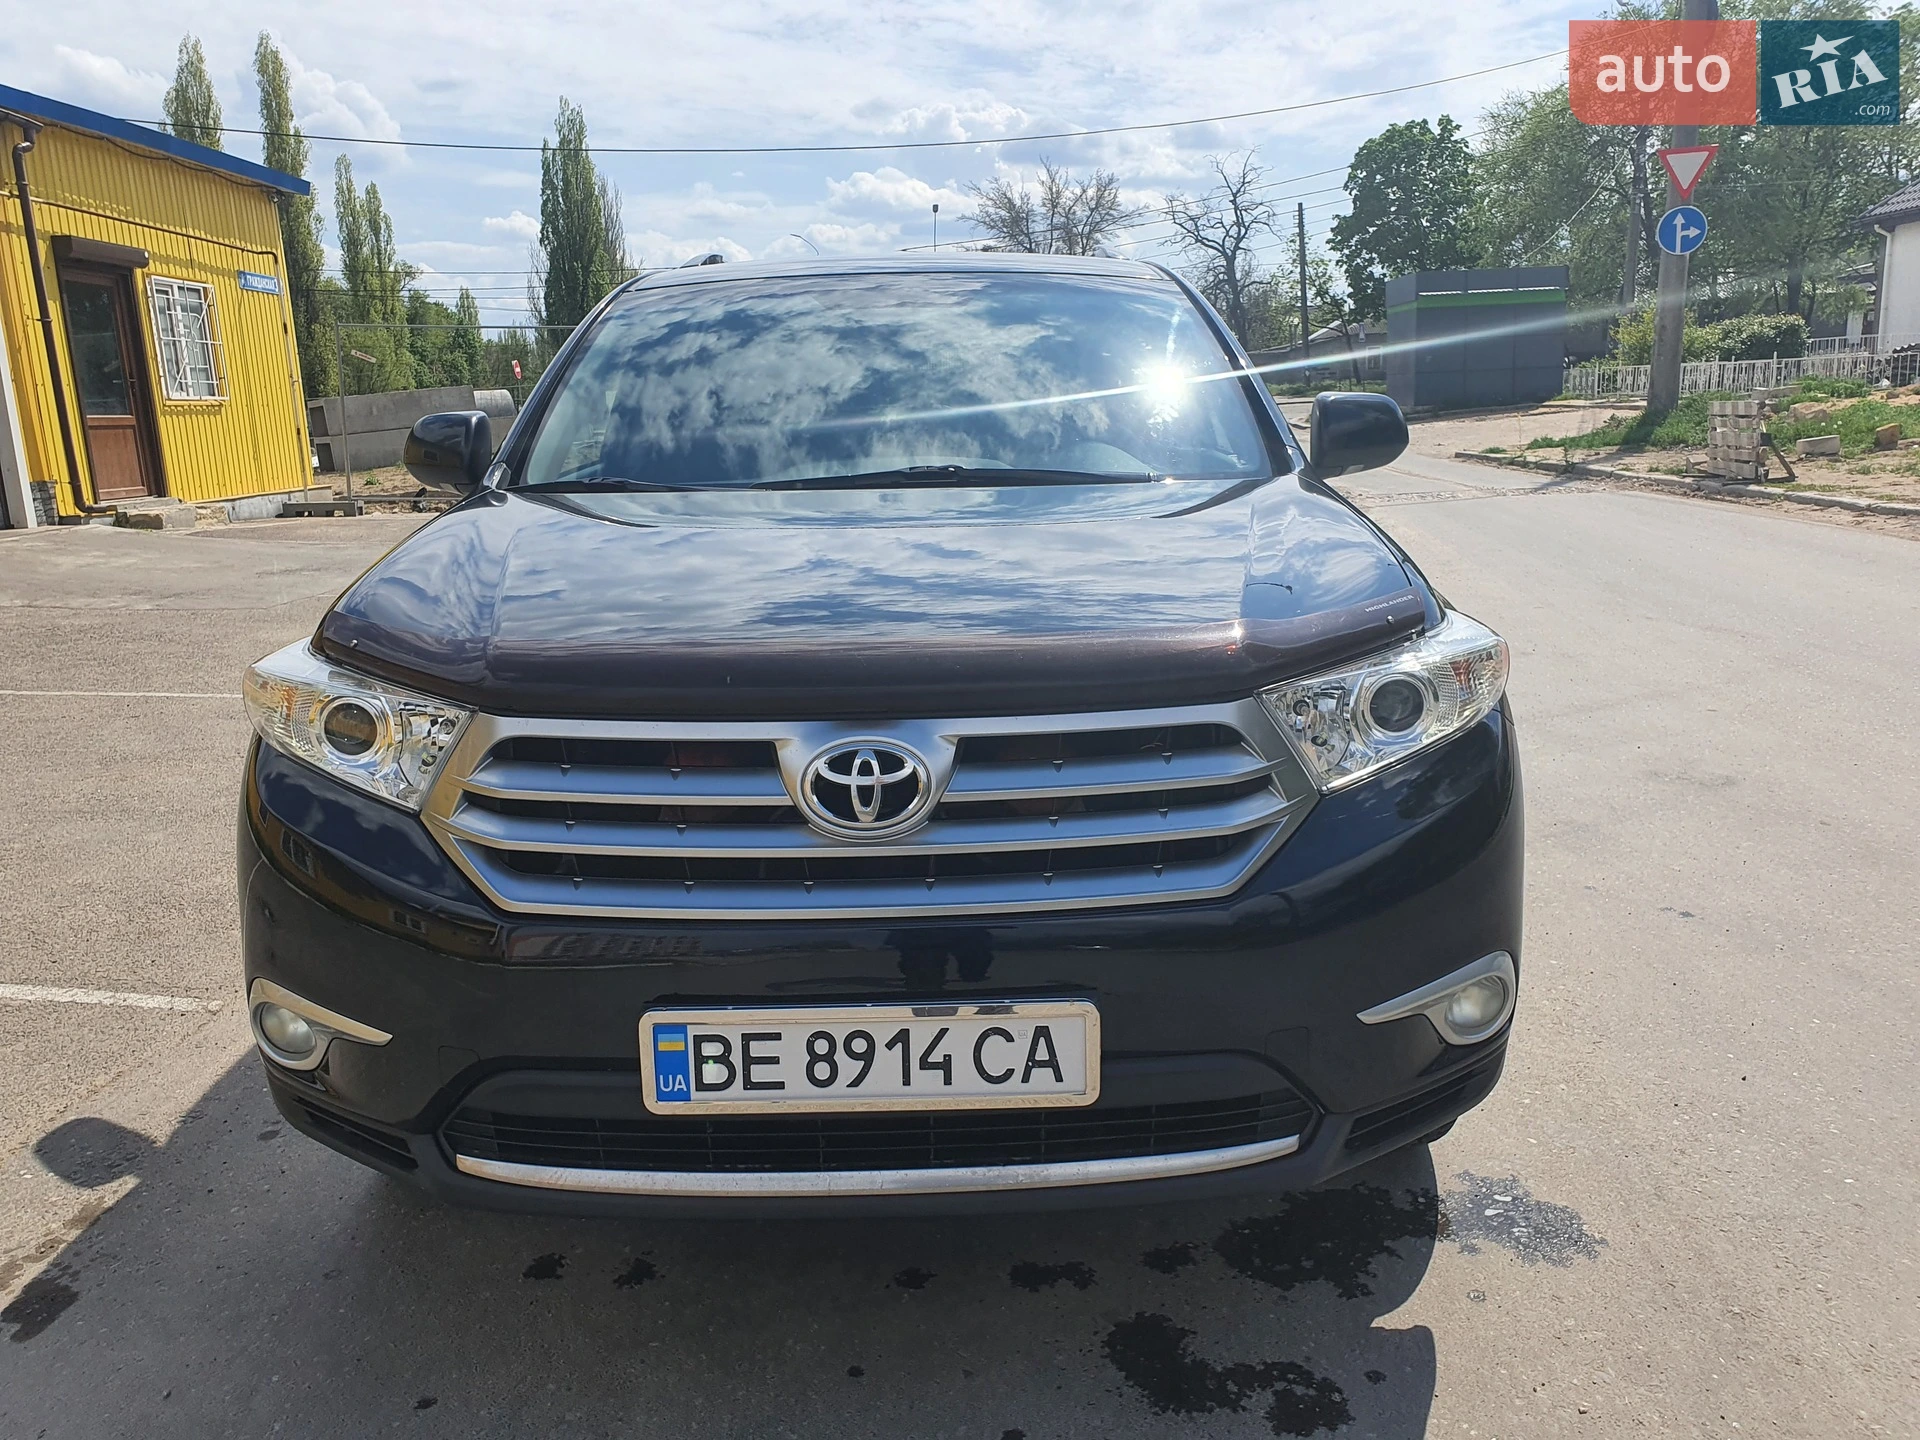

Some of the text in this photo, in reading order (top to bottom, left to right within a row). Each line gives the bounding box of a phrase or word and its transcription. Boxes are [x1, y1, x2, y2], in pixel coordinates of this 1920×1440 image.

[1364, 594, 1415, 613] HIGHLANDER
[693, 1025, 1064, 1092] BE 8914 CA
[659, 1074, 688, 1092] UA
